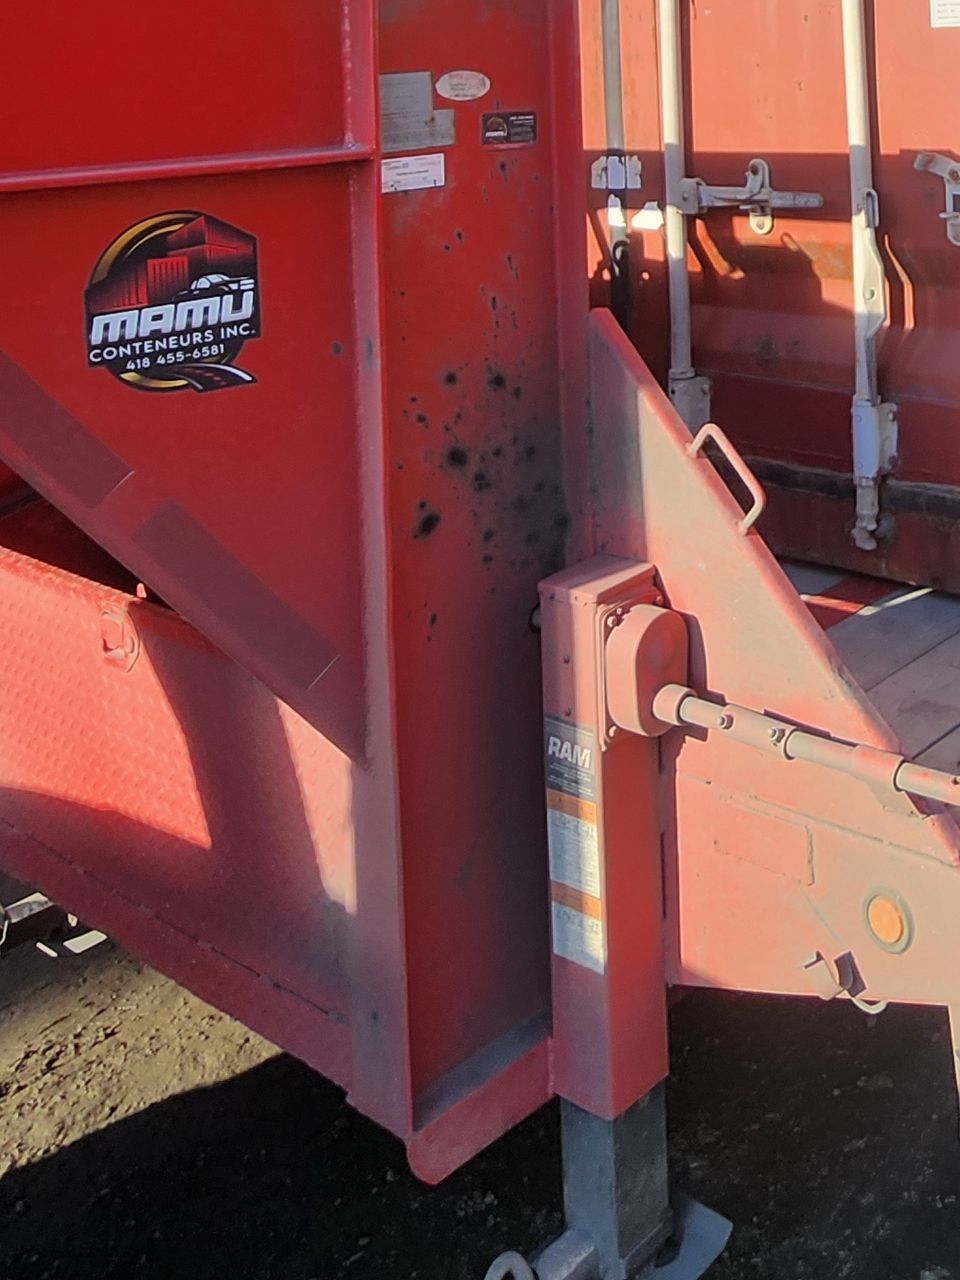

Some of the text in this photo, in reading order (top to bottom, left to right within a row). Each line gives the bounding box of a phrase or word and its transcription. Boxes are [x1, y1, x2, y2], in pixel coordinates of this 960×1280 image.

[91, 290, 254, 346] MAMU
[89, 323, 256, 362] CONTENEURS INC.
[126, 343, 225, 370] 418 455-6581
[548, 735, 592, 769] RAM
